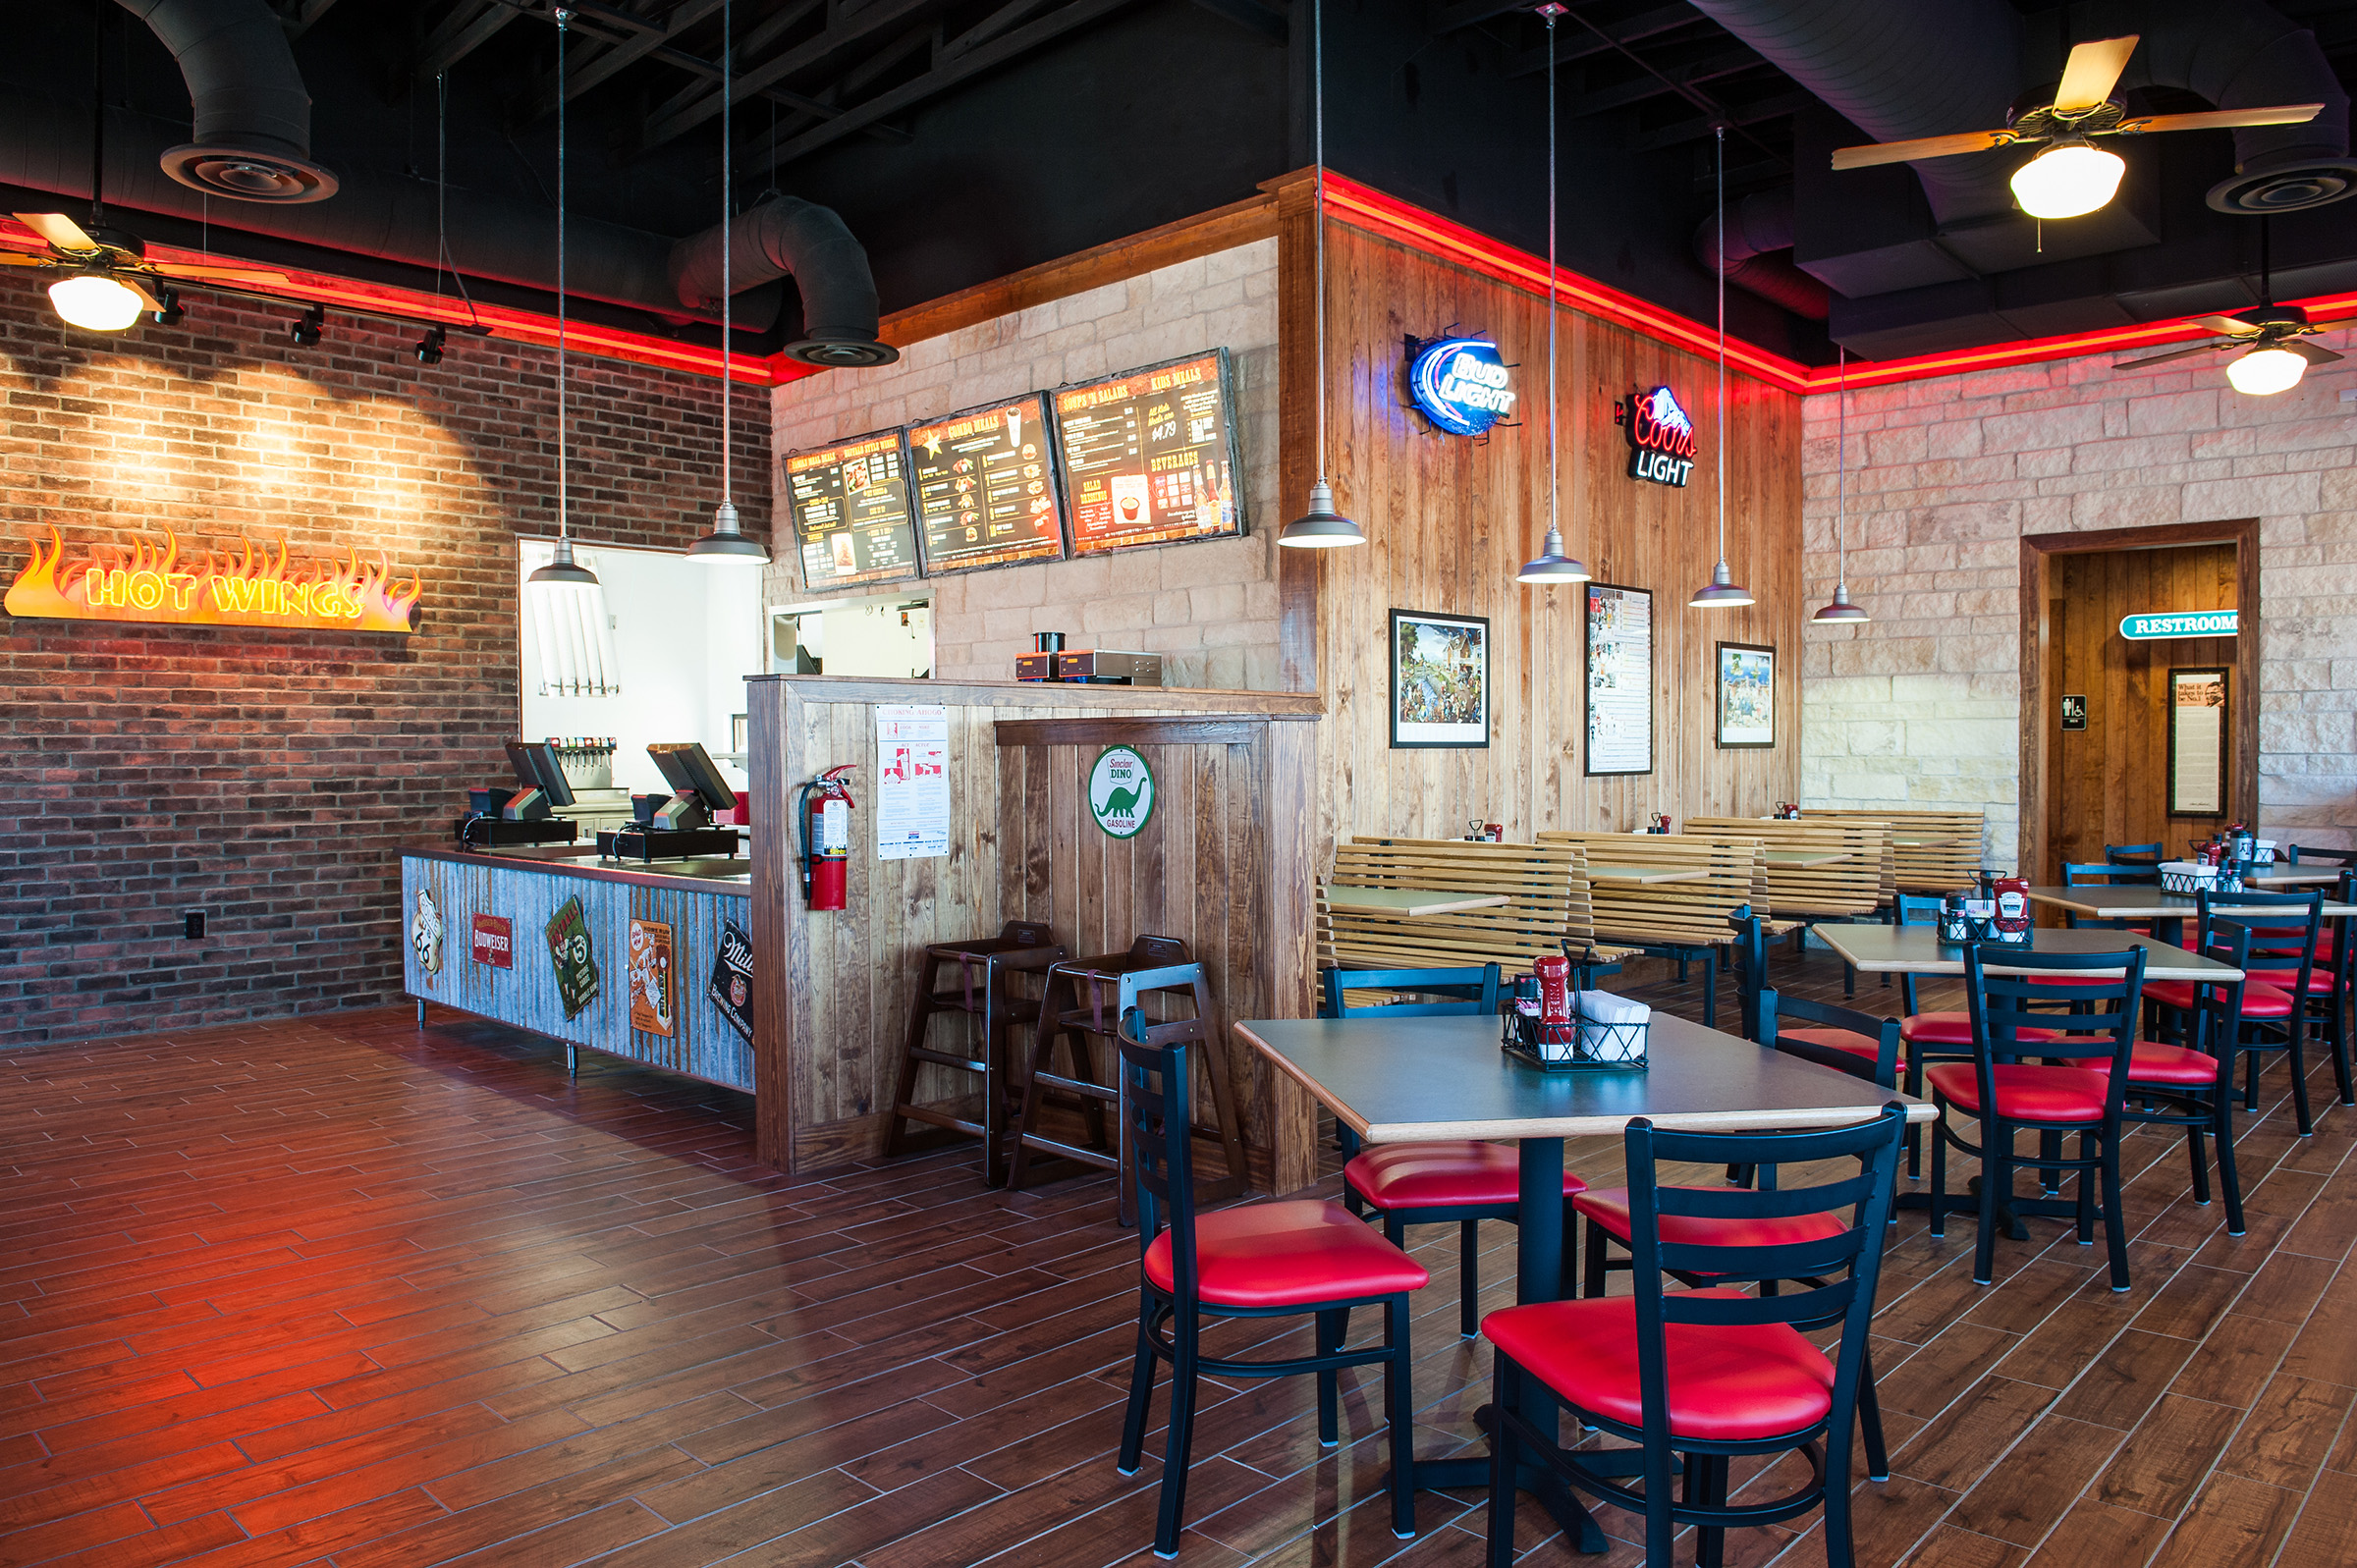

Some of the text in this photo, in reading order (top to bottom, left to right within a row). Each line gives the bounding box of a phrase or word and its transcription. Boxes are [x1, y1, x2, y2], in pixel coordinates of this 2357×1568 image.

[1151, 367, 1202, 391] KIDS MEALS
[1452, 352, 1508, 388] BUD
[1064, 394, 1086, 410] SOUPS
[1098, 385, 1128, 403] SALADS
[1439, 373, 1515, 412] LIGHT
[948, 415, 1000, 439] COMBO MEALS
[1152, 420, 1177, 442] $4.79
[1635, 394, 1697, 458] Coors
[1151, 451, 1199, 472] BEVERAGES
[1637, 450, 1694, 486] LIGHT
[84, 568, 365, 619] HOT WINGS
[2135, 615, 2238, 634] RESTROOM
[1110, 758, 1133, 768] Sinclair
[1111, 769, 1131, 779] DINO
[1107, 819, 1135, 828] GASOLINE
[421, 897, 438, 933] ROUTE
[415, 932, 431, 963] 66
[474, 929, 509, 952] BUDWEISER
[724, 931, 753, 973] Mill
[730, 1006, 753, 1038] COMPANY
